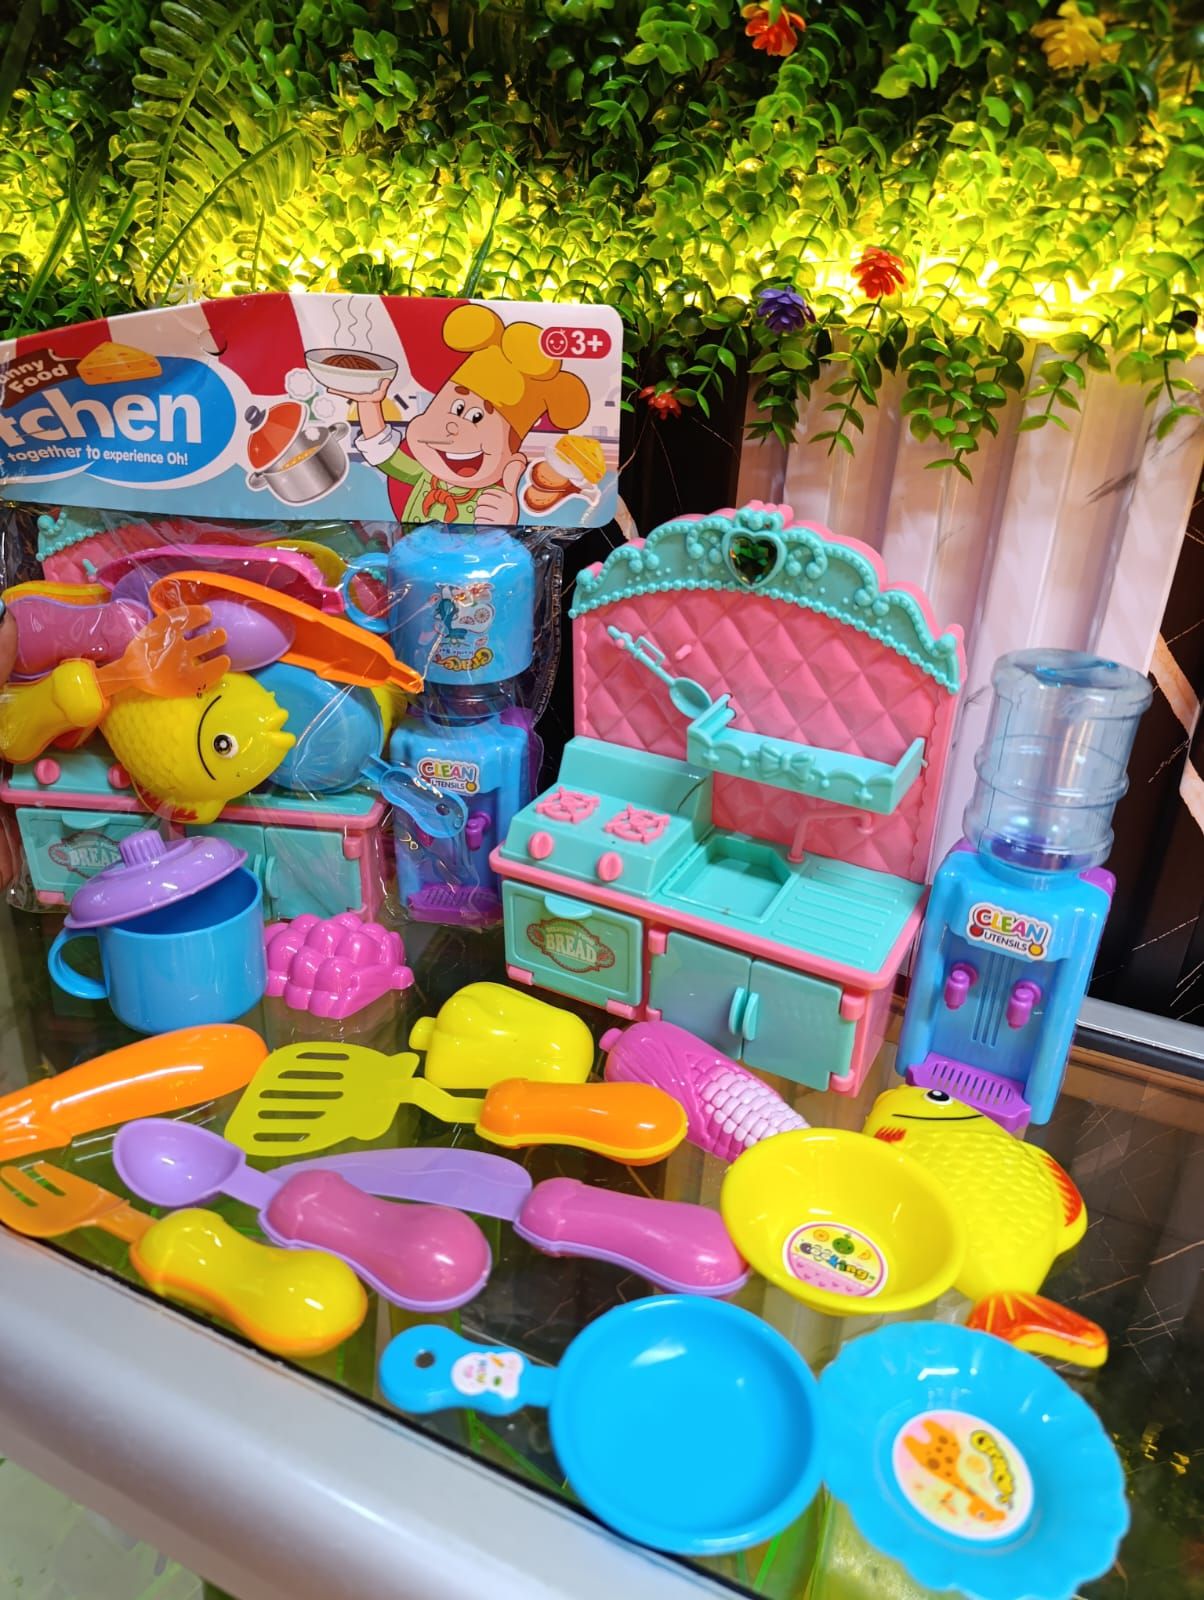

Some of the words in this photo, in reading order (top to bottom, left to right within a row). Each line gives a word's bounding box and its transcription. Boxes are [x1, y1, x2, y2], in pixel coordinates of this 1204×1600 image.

[570, 330, 603, 355] 3+
[8, 364, 69, 394] Food
[8, 444, 82, 462] together
[86, 444, 100, 460] to
[103, 449, 163, 464] experience
[167, 452, 188, 466] Oh!
[421, 761, 475, 781] CLEAN
[975, 908, 1045, 944] CLEAN
[545, 932, 598, 964] BREAD
[984, 931, 1028, 952] UTENSILS
